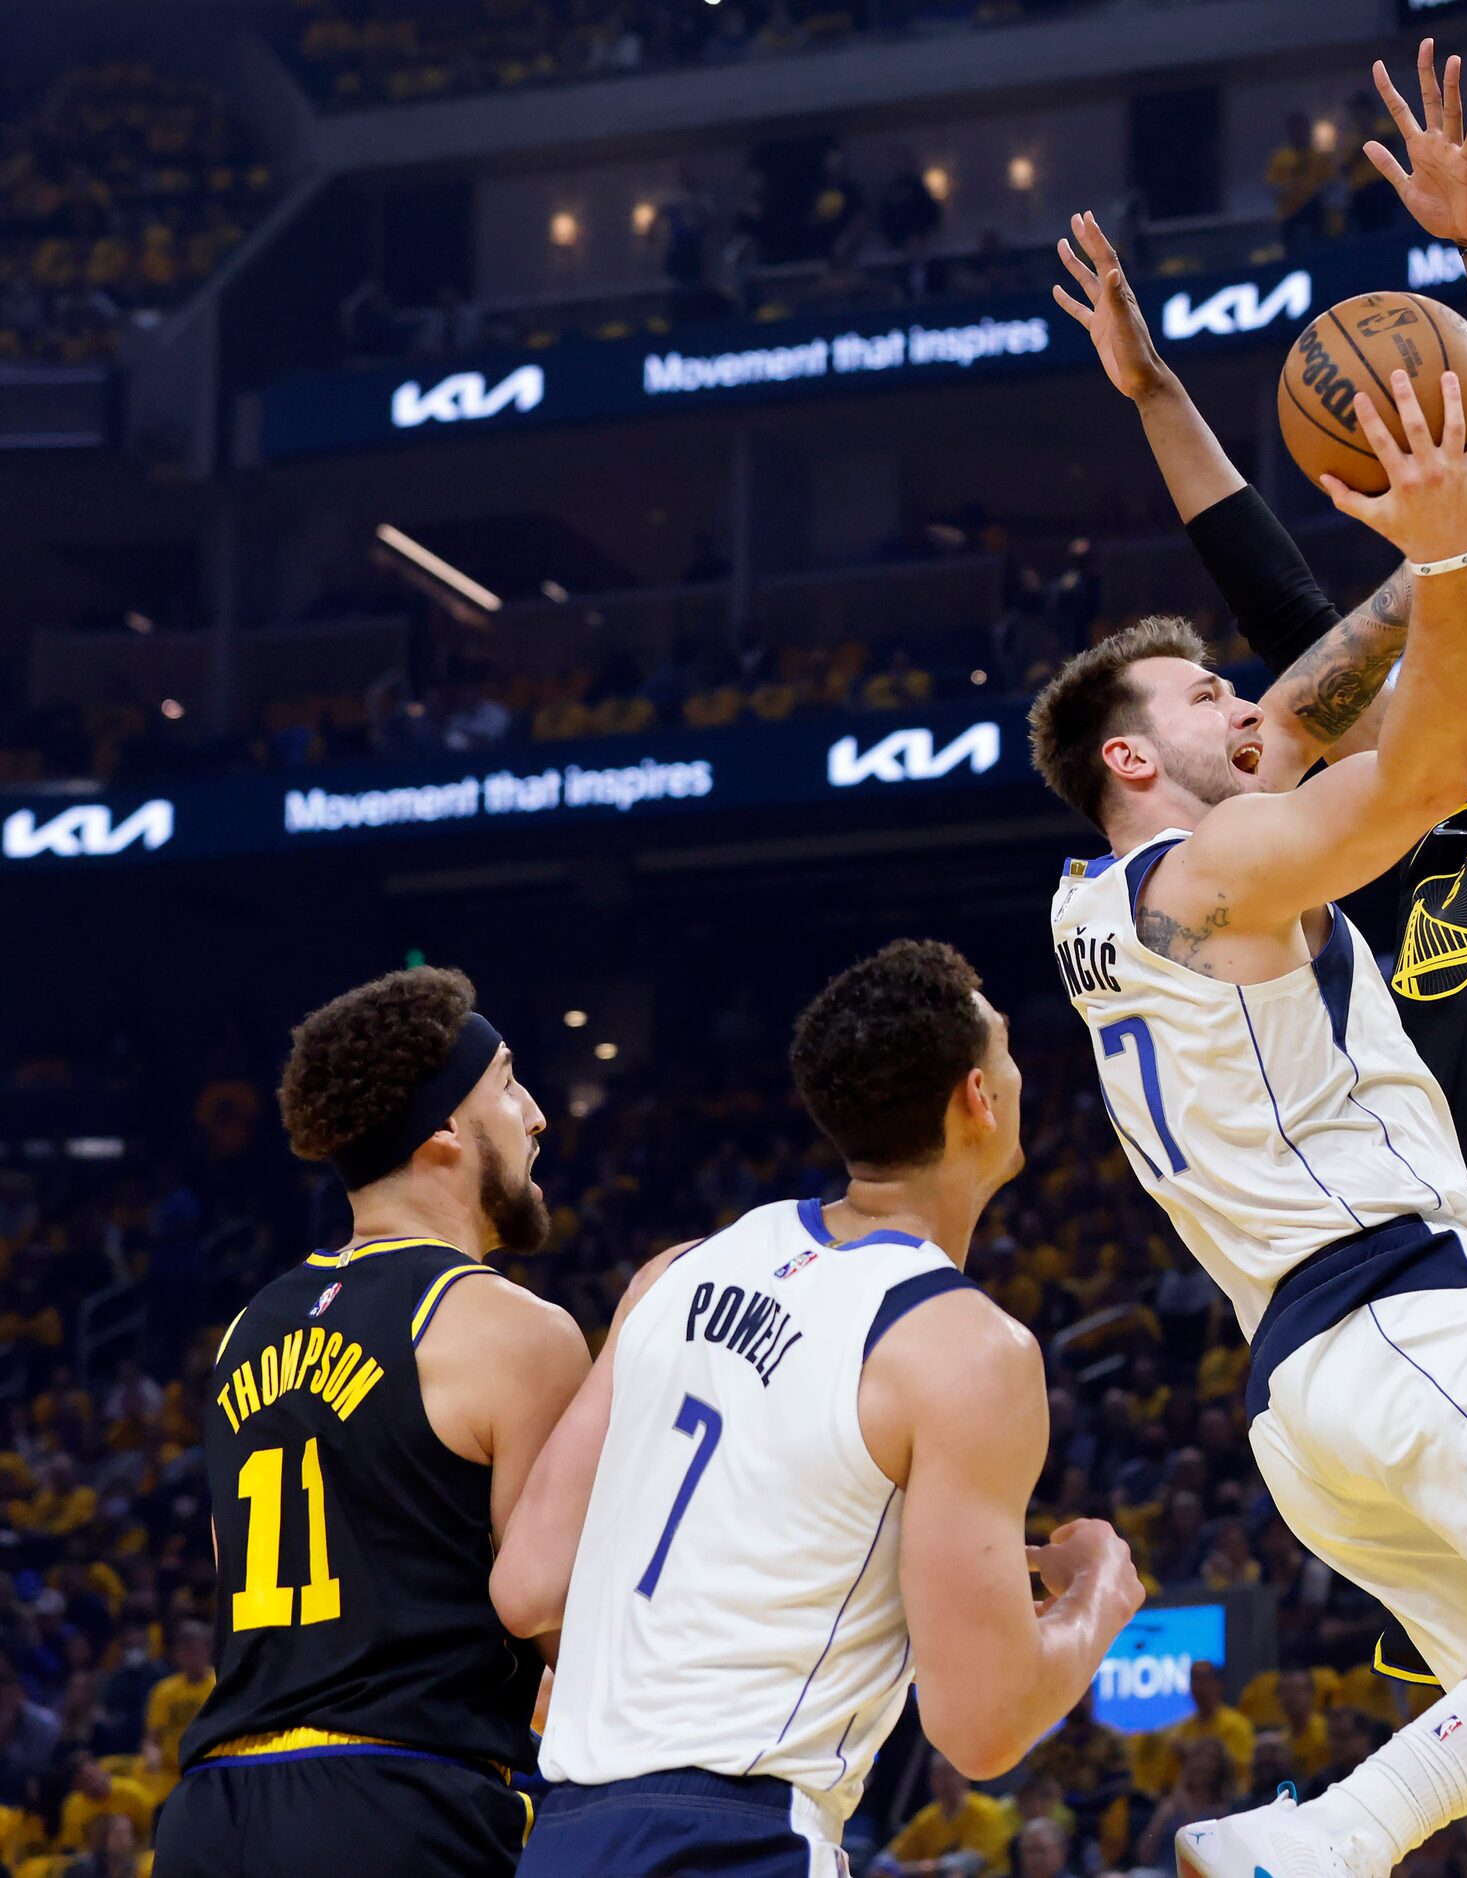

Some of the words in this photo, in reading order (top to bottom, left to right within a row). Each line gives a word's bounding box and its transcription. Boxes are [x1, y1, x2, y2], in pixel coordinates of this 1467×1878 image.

[644, 338, 828, 394] Movement
[832, 331, 905, 373] that
[909, 317, 1049, 366] inspires
[284, 776, 480, 833] Movement
[483, 768, 562, 814] that
[564, 758, 713, 811] inspires
[827, 721, 1001, 787] KIA
[1056, 927, 1122, 998] NČIĆ
[686, 1282, 803, 1388] POWELL
[216, 1327, 385, 1435] THOMPSON
[232, 1437, 341, 1633] 11
[634, 1391, 723, 1602] 7
